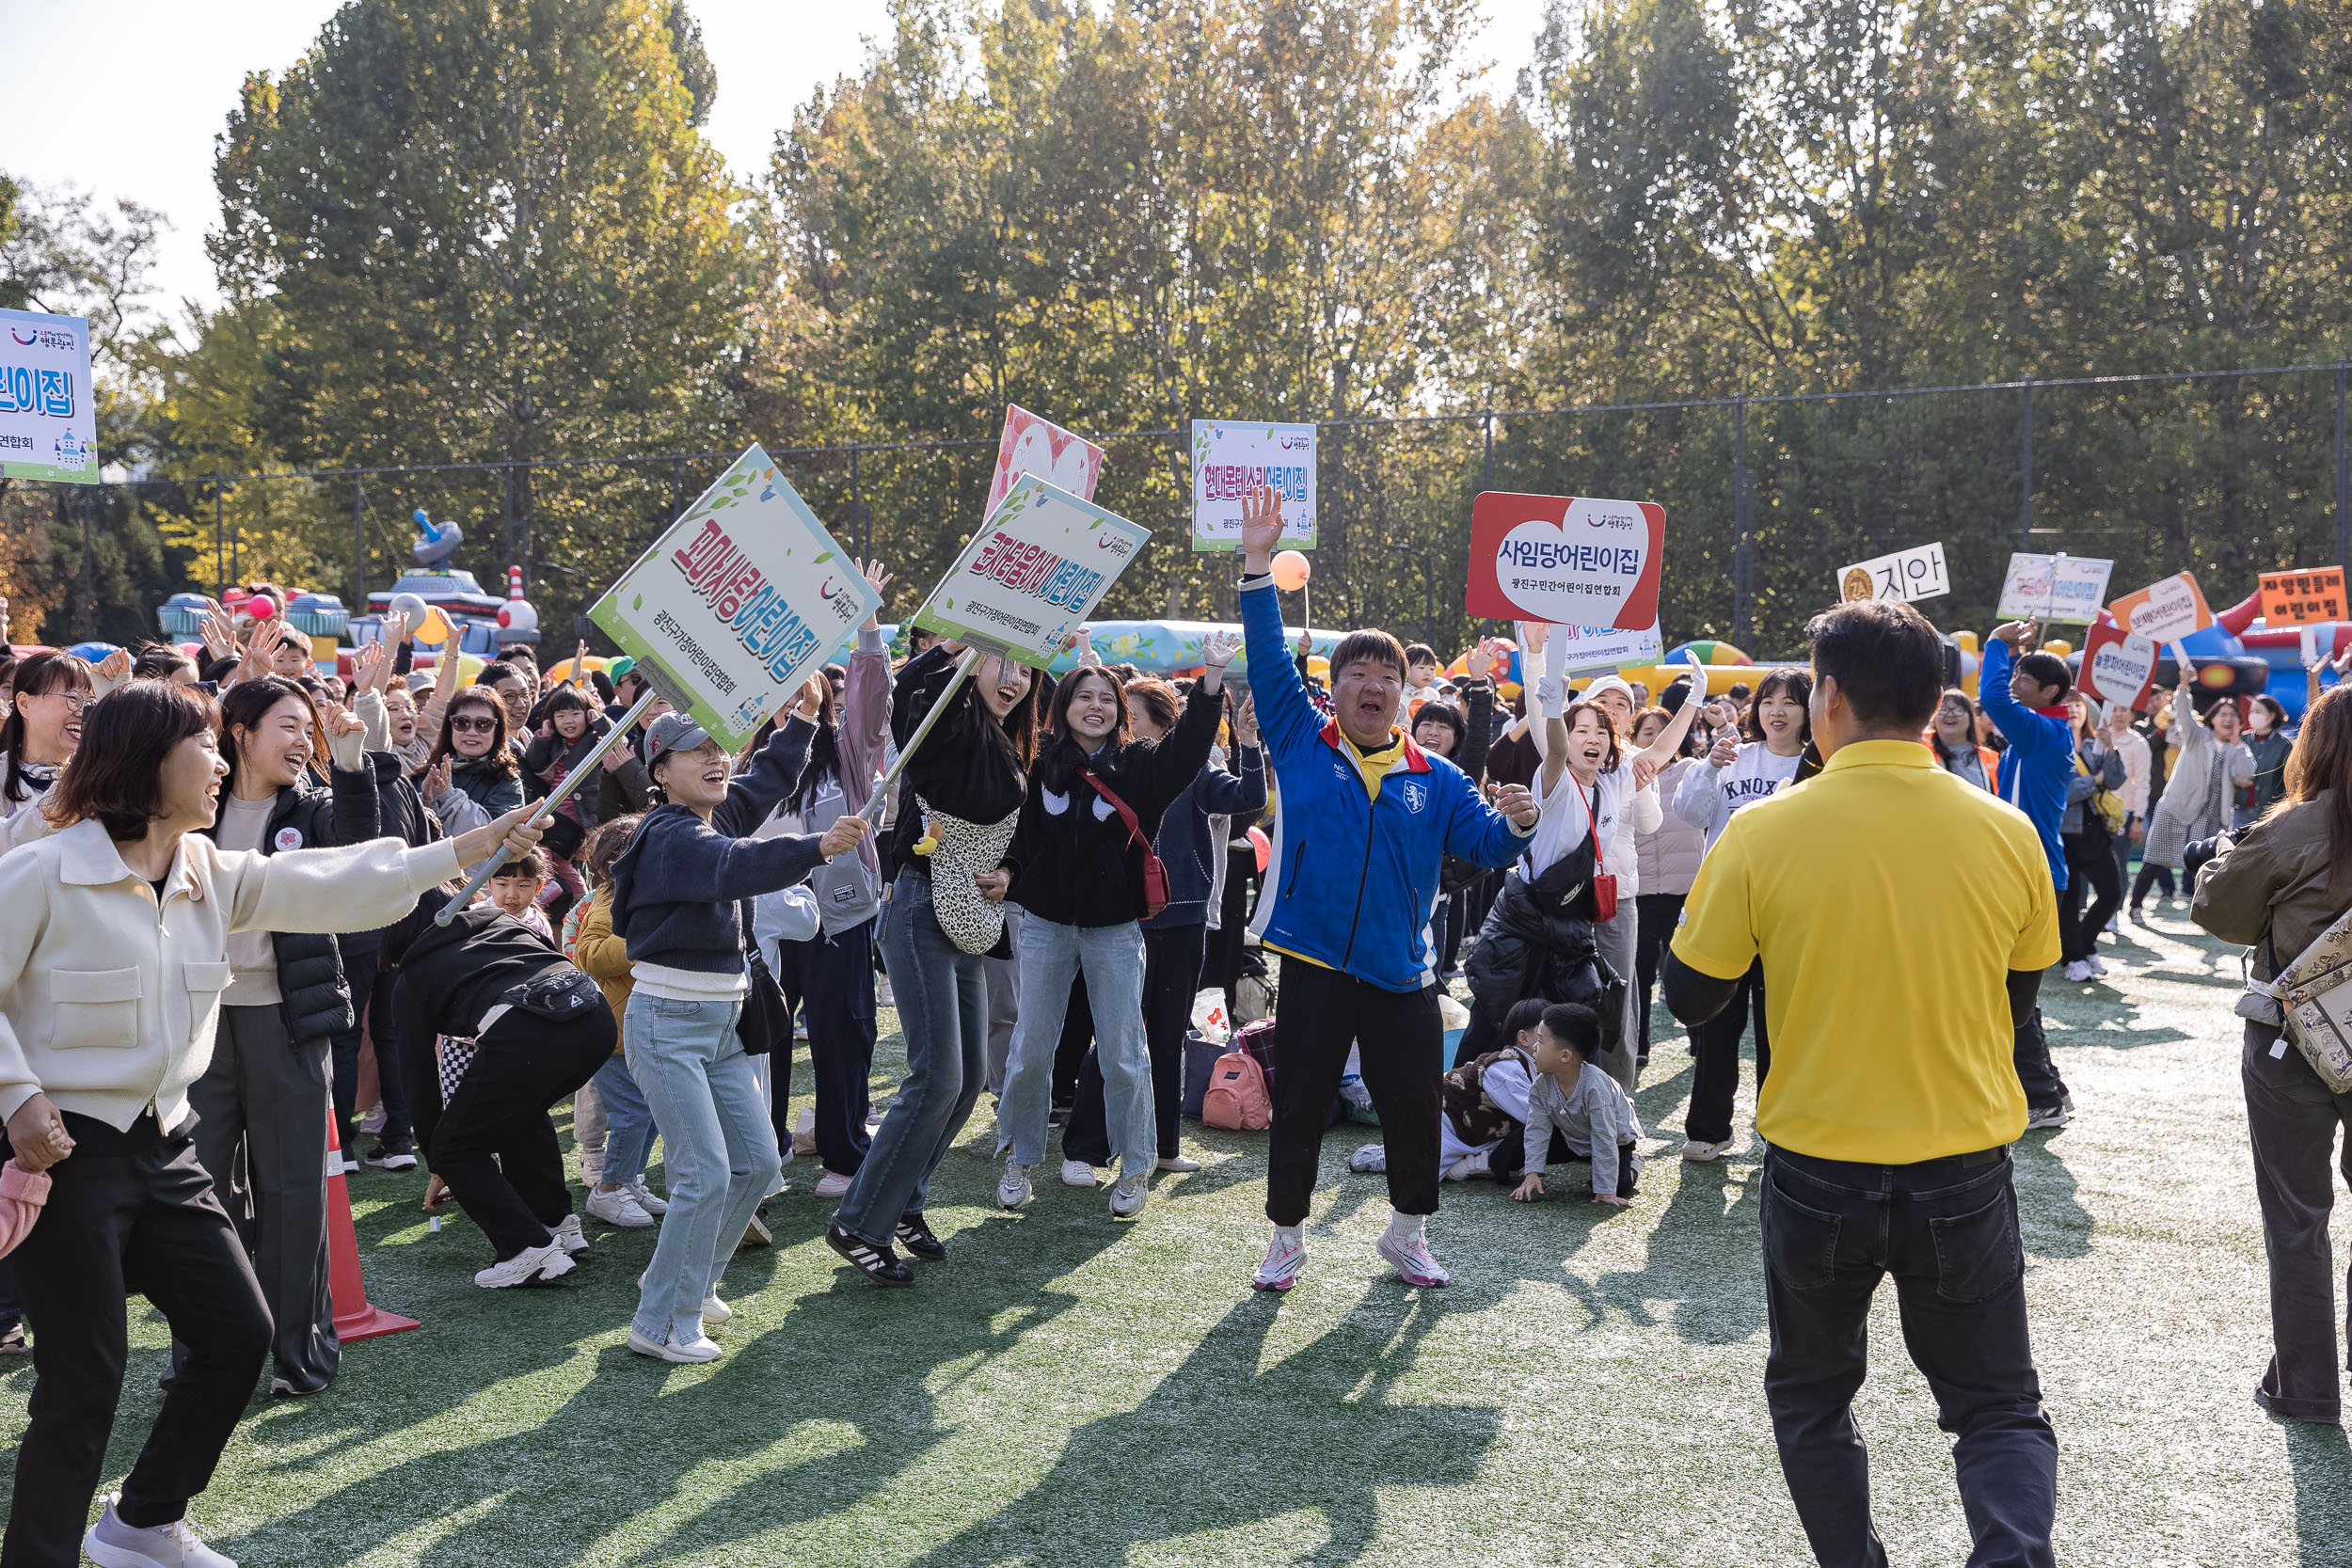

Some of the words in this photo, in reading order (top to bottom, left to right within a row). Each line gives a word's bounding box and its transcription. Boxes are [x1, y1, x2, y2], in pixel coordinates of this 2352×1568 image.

[40, 337, 75, 350] 행복광진
[1499, 540, 1640, 576] 사임당어린이집
[969, 531, 1106, 614] 군자티움아이어린이집
[1511, 578, 1621, 597] 광진구민간어린이집연합회
[671, 518, 821, 685] 꼬마사랑어린이집
[2274, 599, 2338, 620] 어린이집
[965, 600, 1041, 637] 광진구가정어린이집연합회
[653, 610, 738, 697] 광진구가정어린이집연합회
[1566, 645, 1629, 661] 구가정어린이집연합회
[1724, 778, 1777, 800] KNOX
[1564, 883, 1581, 901] NIKE
